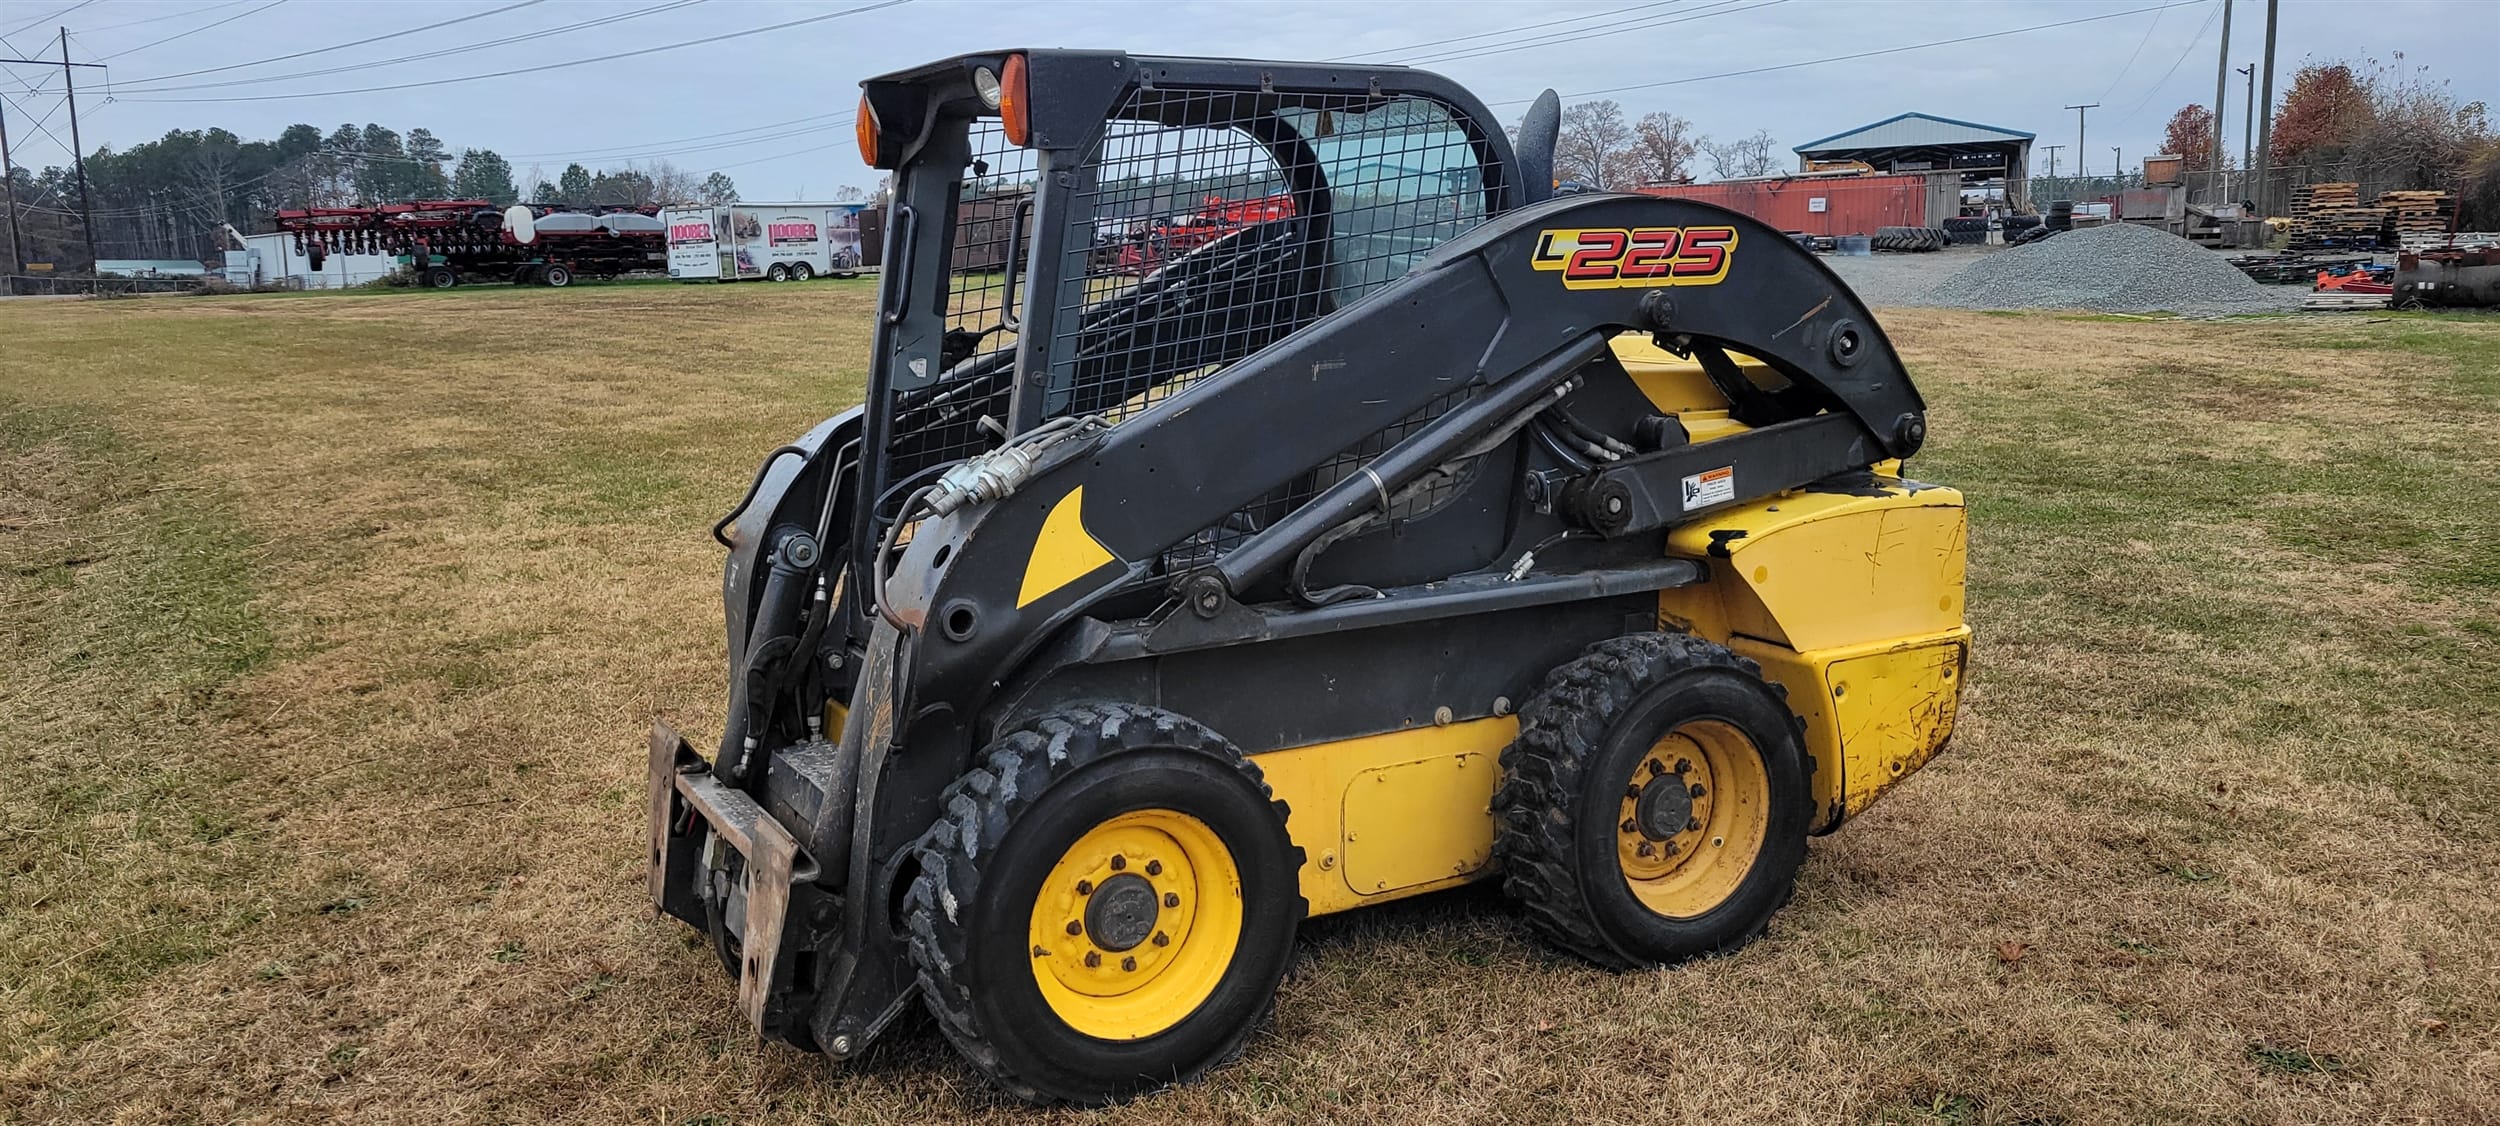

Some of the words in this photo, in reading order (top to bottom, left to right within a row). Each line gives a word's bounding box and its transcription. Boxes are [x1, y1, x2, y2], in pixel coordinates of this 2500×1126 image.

[670, 223, 711, 250] HOOBER
[768, 223, 818, 247] HOOBER
[1534, 228, 1735, 284] L225
